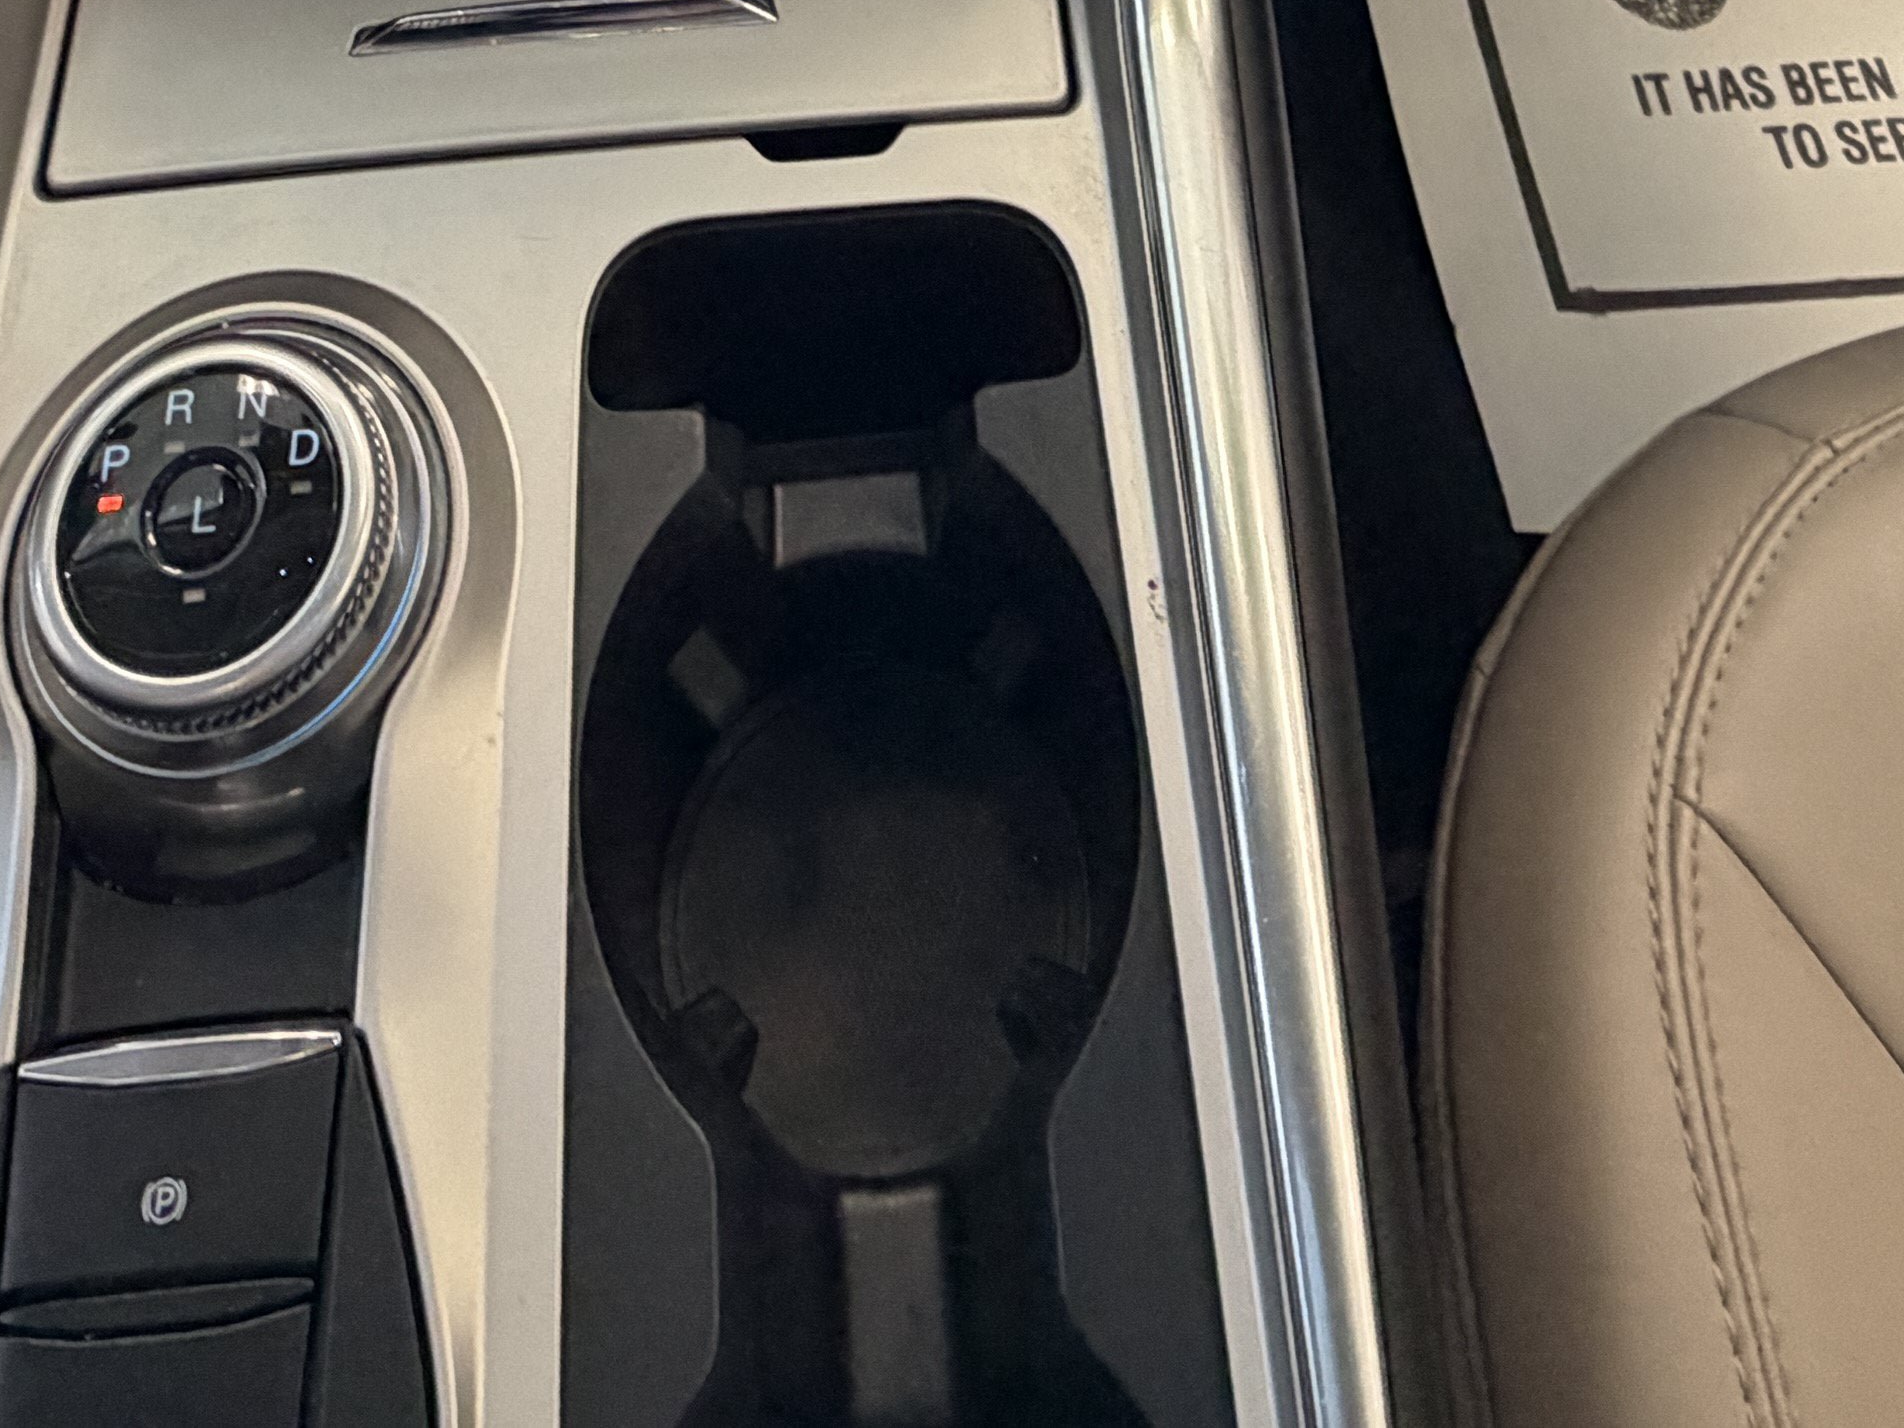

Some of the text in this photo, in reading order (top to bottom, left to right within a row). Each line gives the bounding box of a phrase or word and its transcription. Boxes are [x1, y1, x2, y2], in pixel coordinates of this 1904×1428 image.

[1632, 73, 1673, 116] IT
[1684, 67, 1777, 113] HAS
[1780, 55, 1897, 108] BEEN
[1762, 124, 1829, 171] TO
[164, 388, 196, 426] R
[237, 384, 269, 420] N
[100, 443, 132, 484] P
[287, 428, 322, 468] D
[191, 495, 218, 535] L
